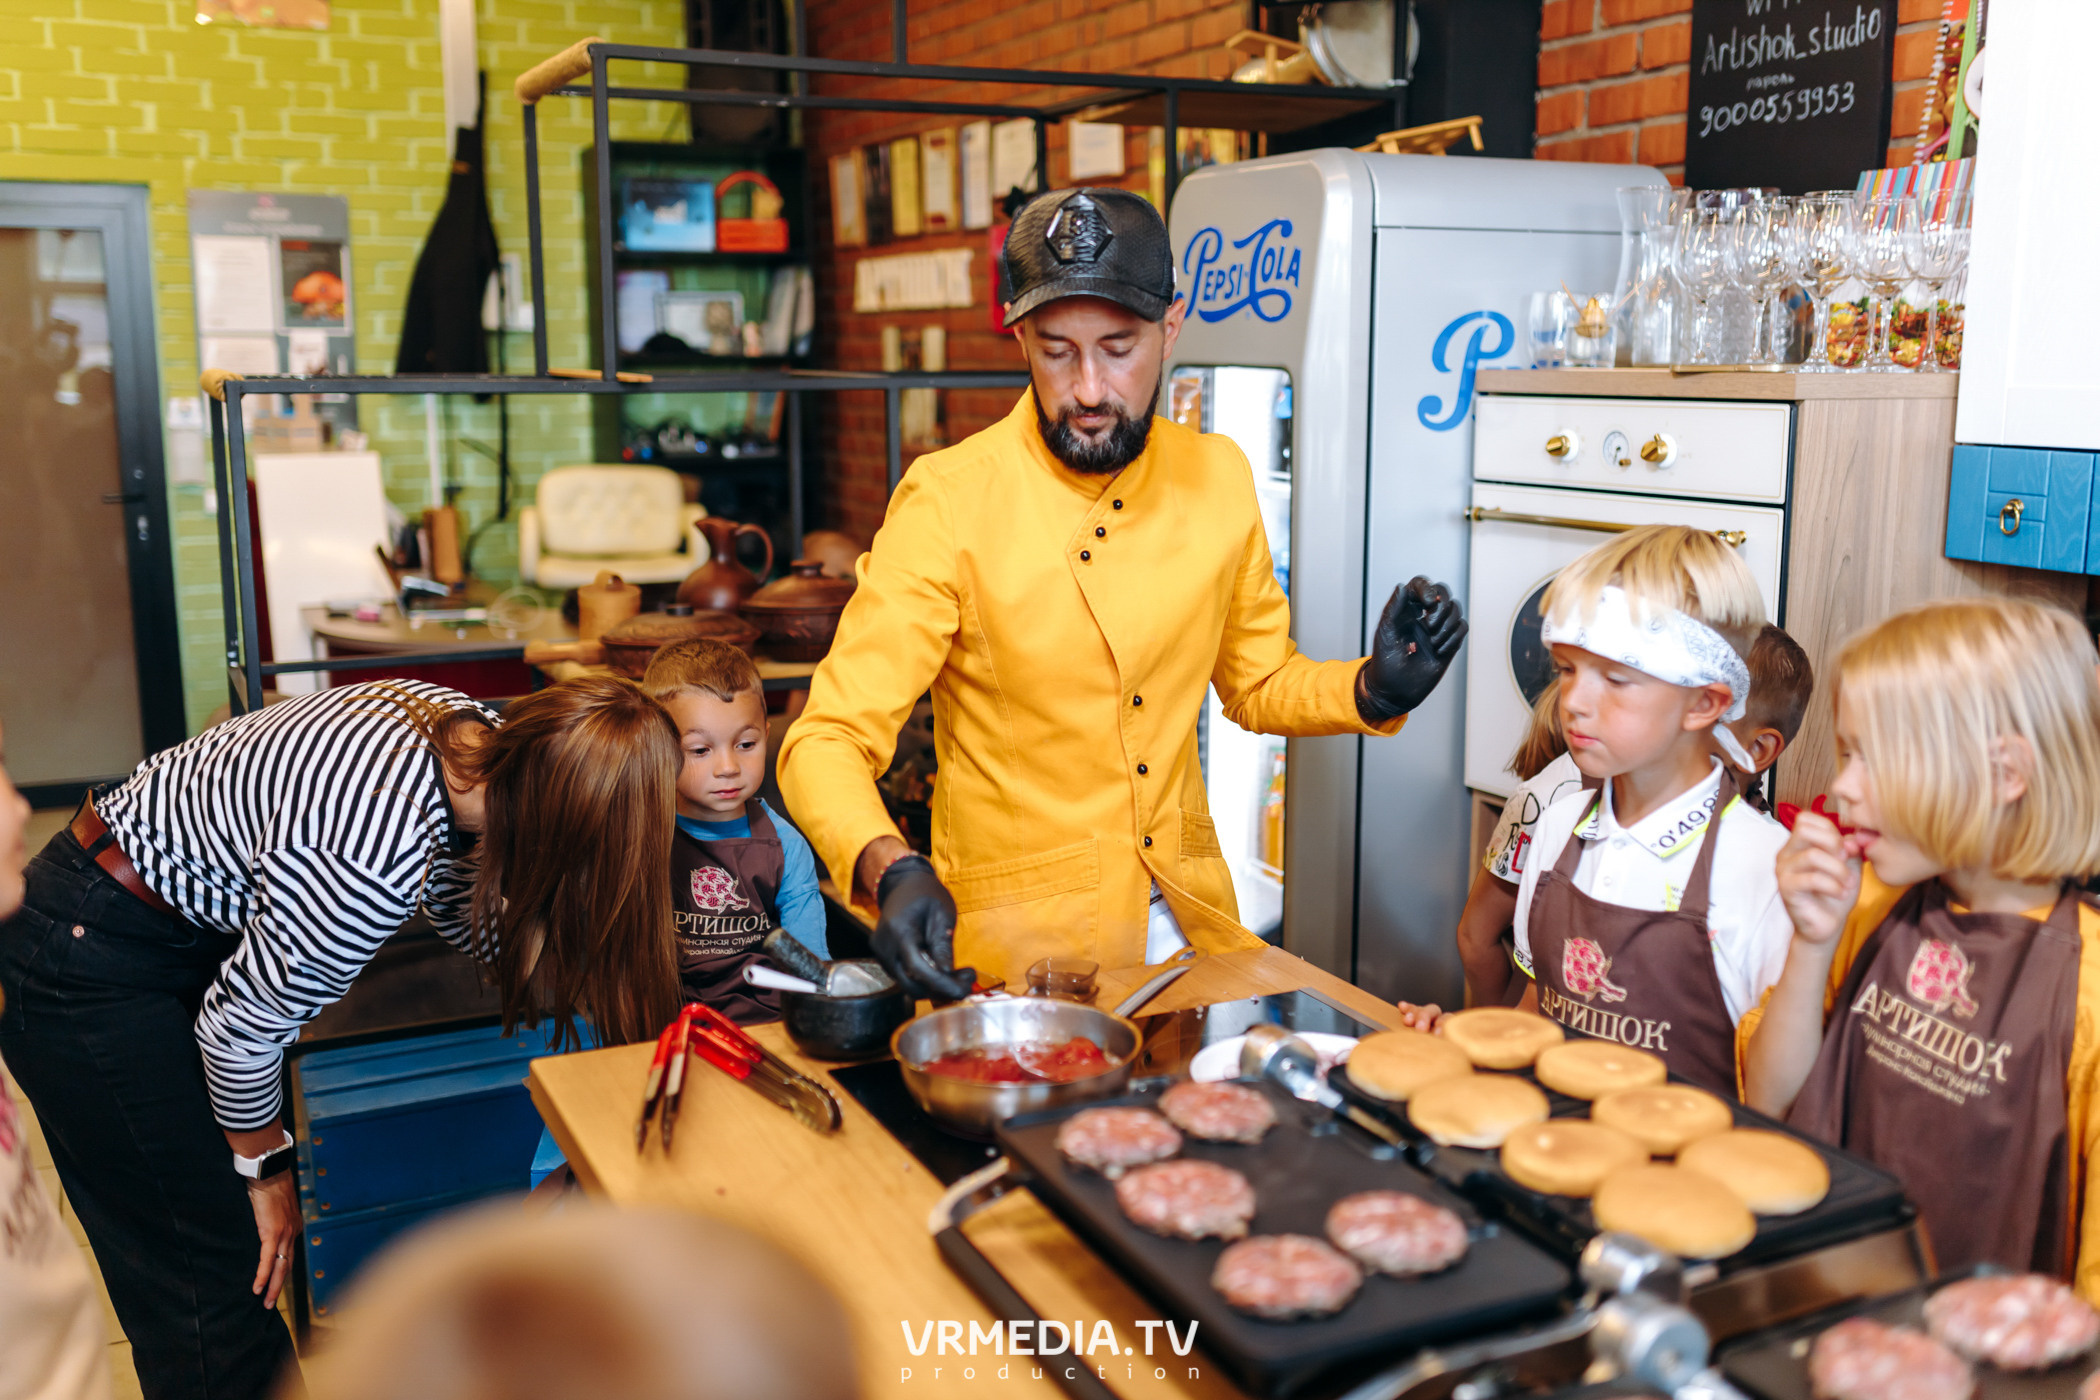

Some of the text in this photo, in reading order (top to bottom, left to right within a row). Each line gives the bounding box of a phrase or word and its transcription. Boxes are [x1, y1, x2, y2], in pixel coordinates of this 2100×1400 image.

[1700, 81, 1855, 138] 9000559953
[1541, 984, 1671, 1051] АРТИШОК
[1851, 980, 2013, 1083] АРТИШОК
